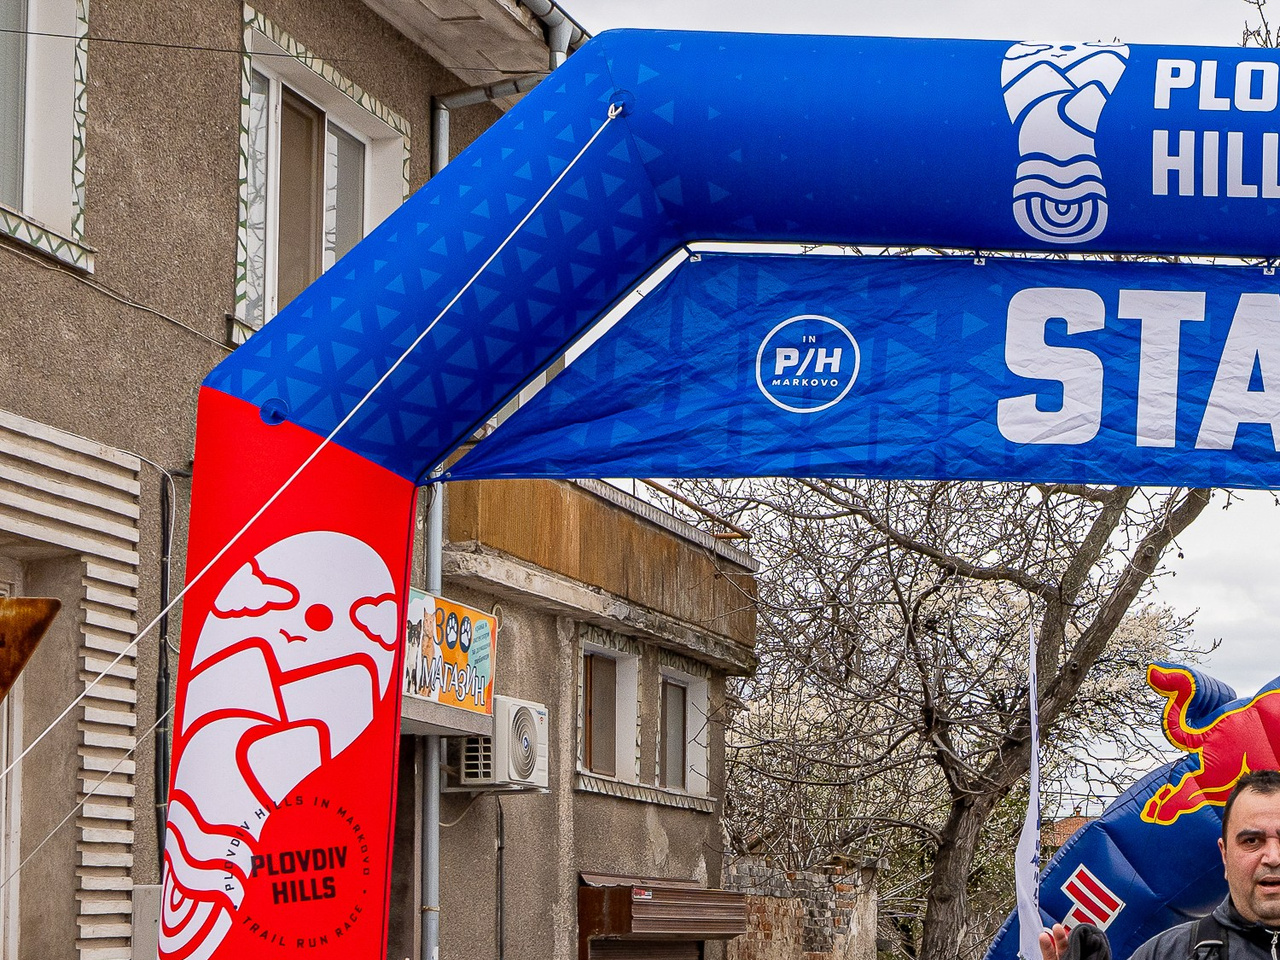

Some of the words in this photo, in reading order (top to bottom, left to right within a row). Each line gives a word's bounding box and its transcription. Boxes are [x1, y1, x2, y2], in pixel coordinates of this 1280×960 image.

[802, 335, 816, 343] IN
[774, 347, 842, 376] P/H
[771, 379, 839, 387] MARKOVO
[421, 655, 486, 706] МАГАЗИН
[224, 821, 250, 891] PLOVDIV
[254, 795, 304, 820] HILLS
[313, 797, 330, 809] IN
[336, 806, 370, 876] MARKOVO
[250, 846, 348, 878] PLOVDIV
[272, 876, 336, 905] HILLS
[242, 916, 286, 946] TRAIL
[296, 935, 328, 948] RUN
[334, 904, 363, 938] RACE
